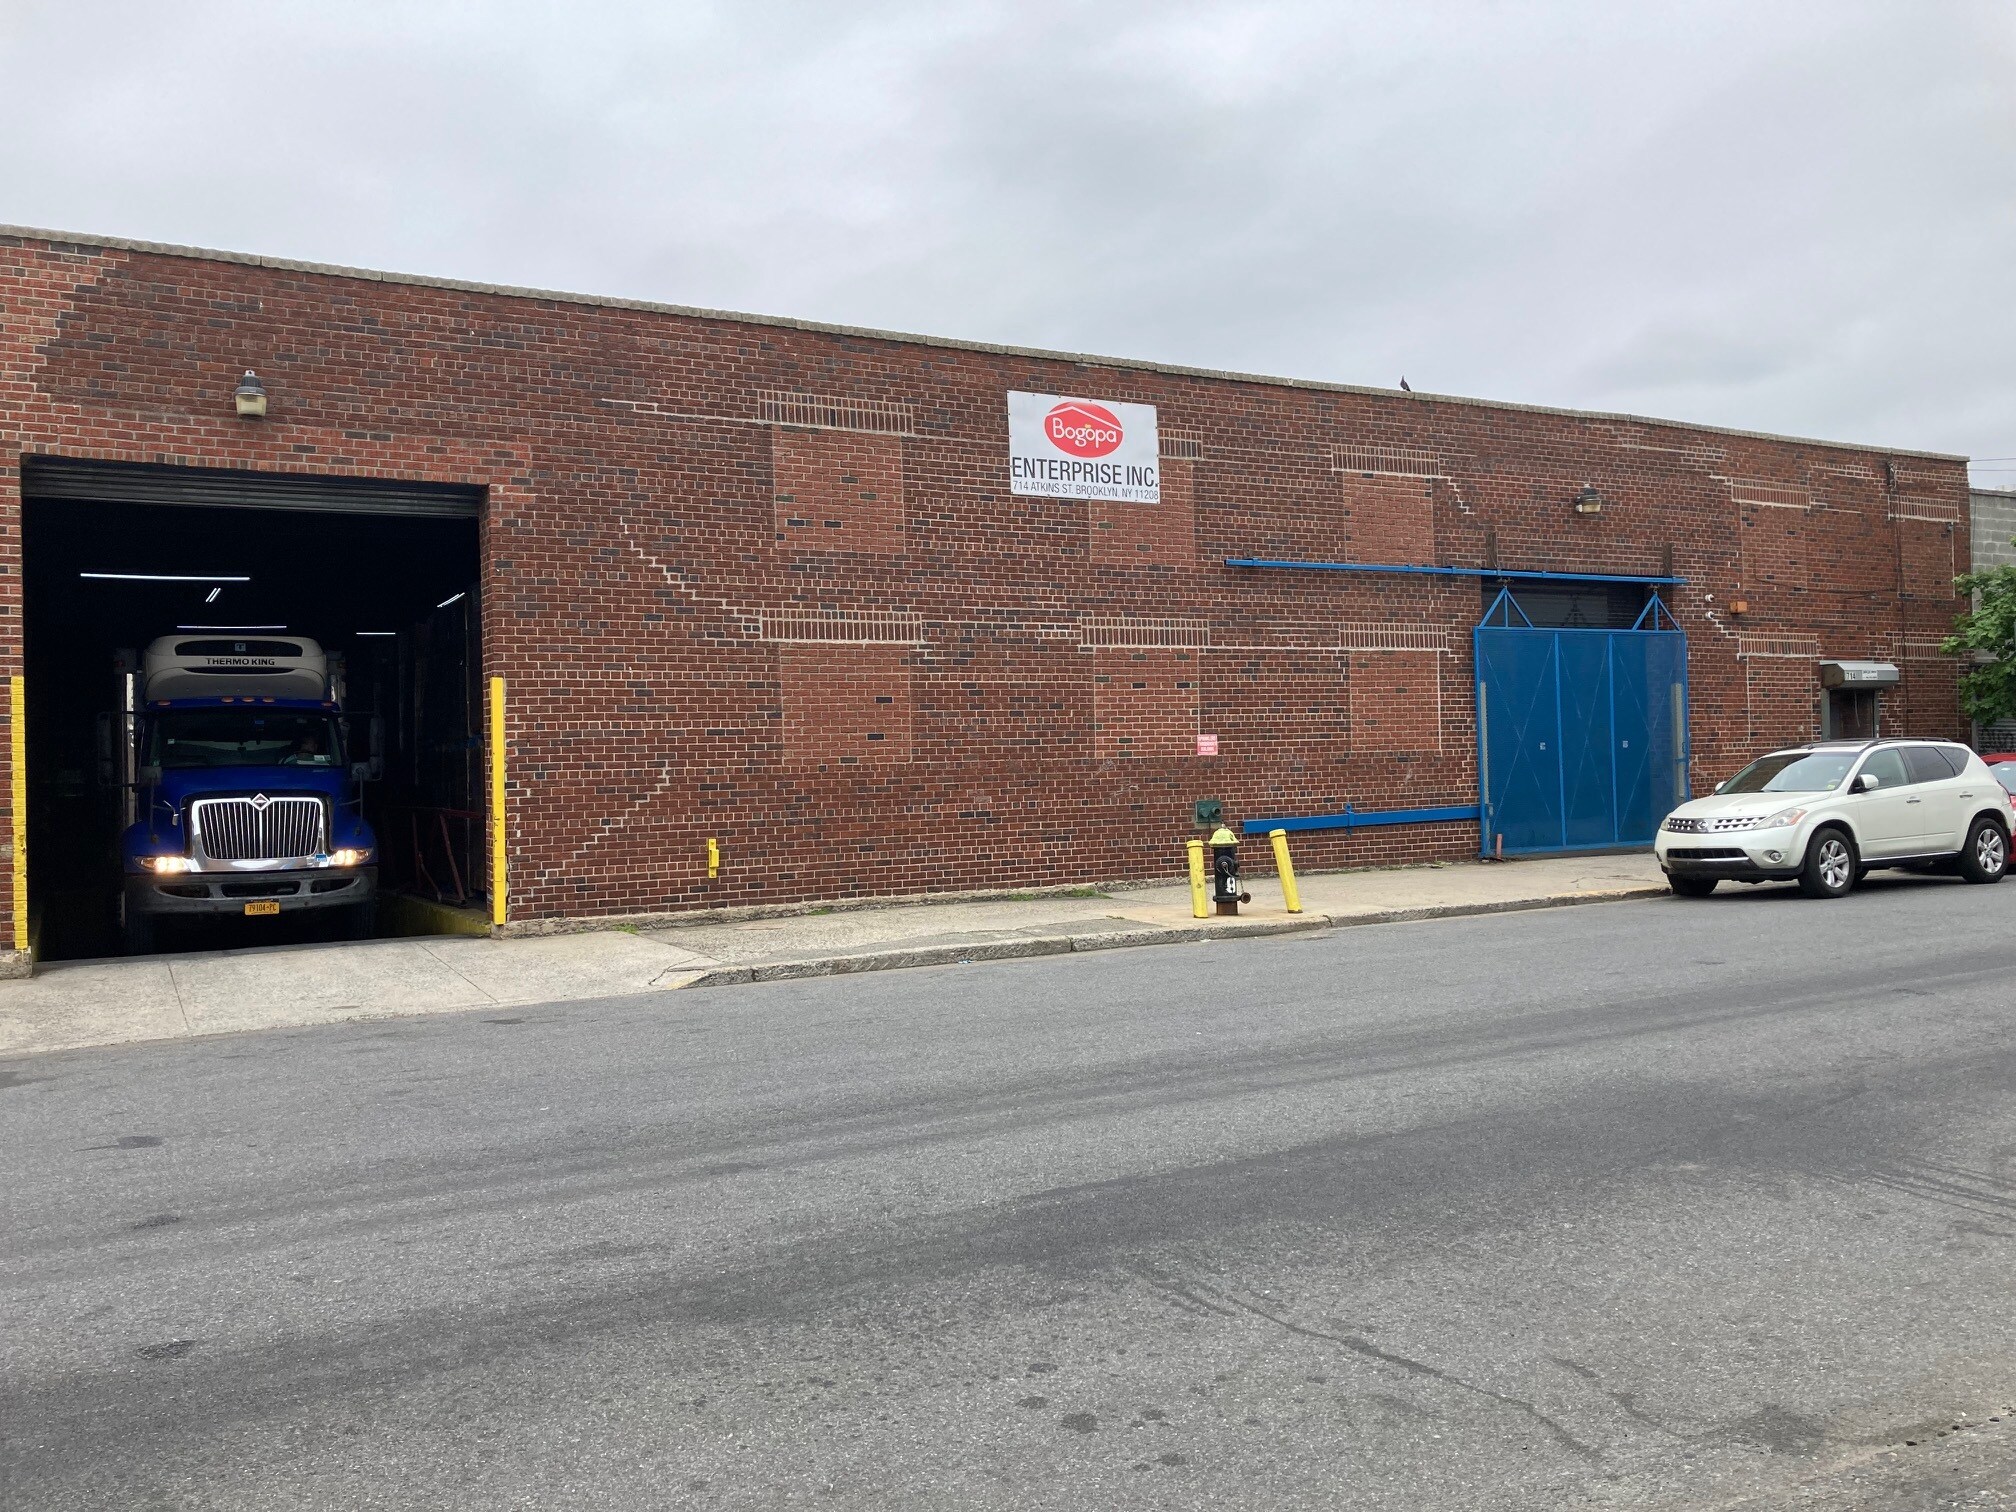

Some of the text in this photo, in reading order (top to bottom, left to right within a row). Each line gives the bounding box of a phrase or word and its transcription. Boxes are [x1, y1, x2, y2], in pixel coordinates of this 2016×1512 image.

[1052, 417, 1117, 448] Bogopa
[1012, 456, 1159, 488] ENTERPRISE INC.
[1013, 480, 1159, 500] 714 ATKINS ST. BROOKLYN, NY 11208
[251, 658, 275, 666] KING
